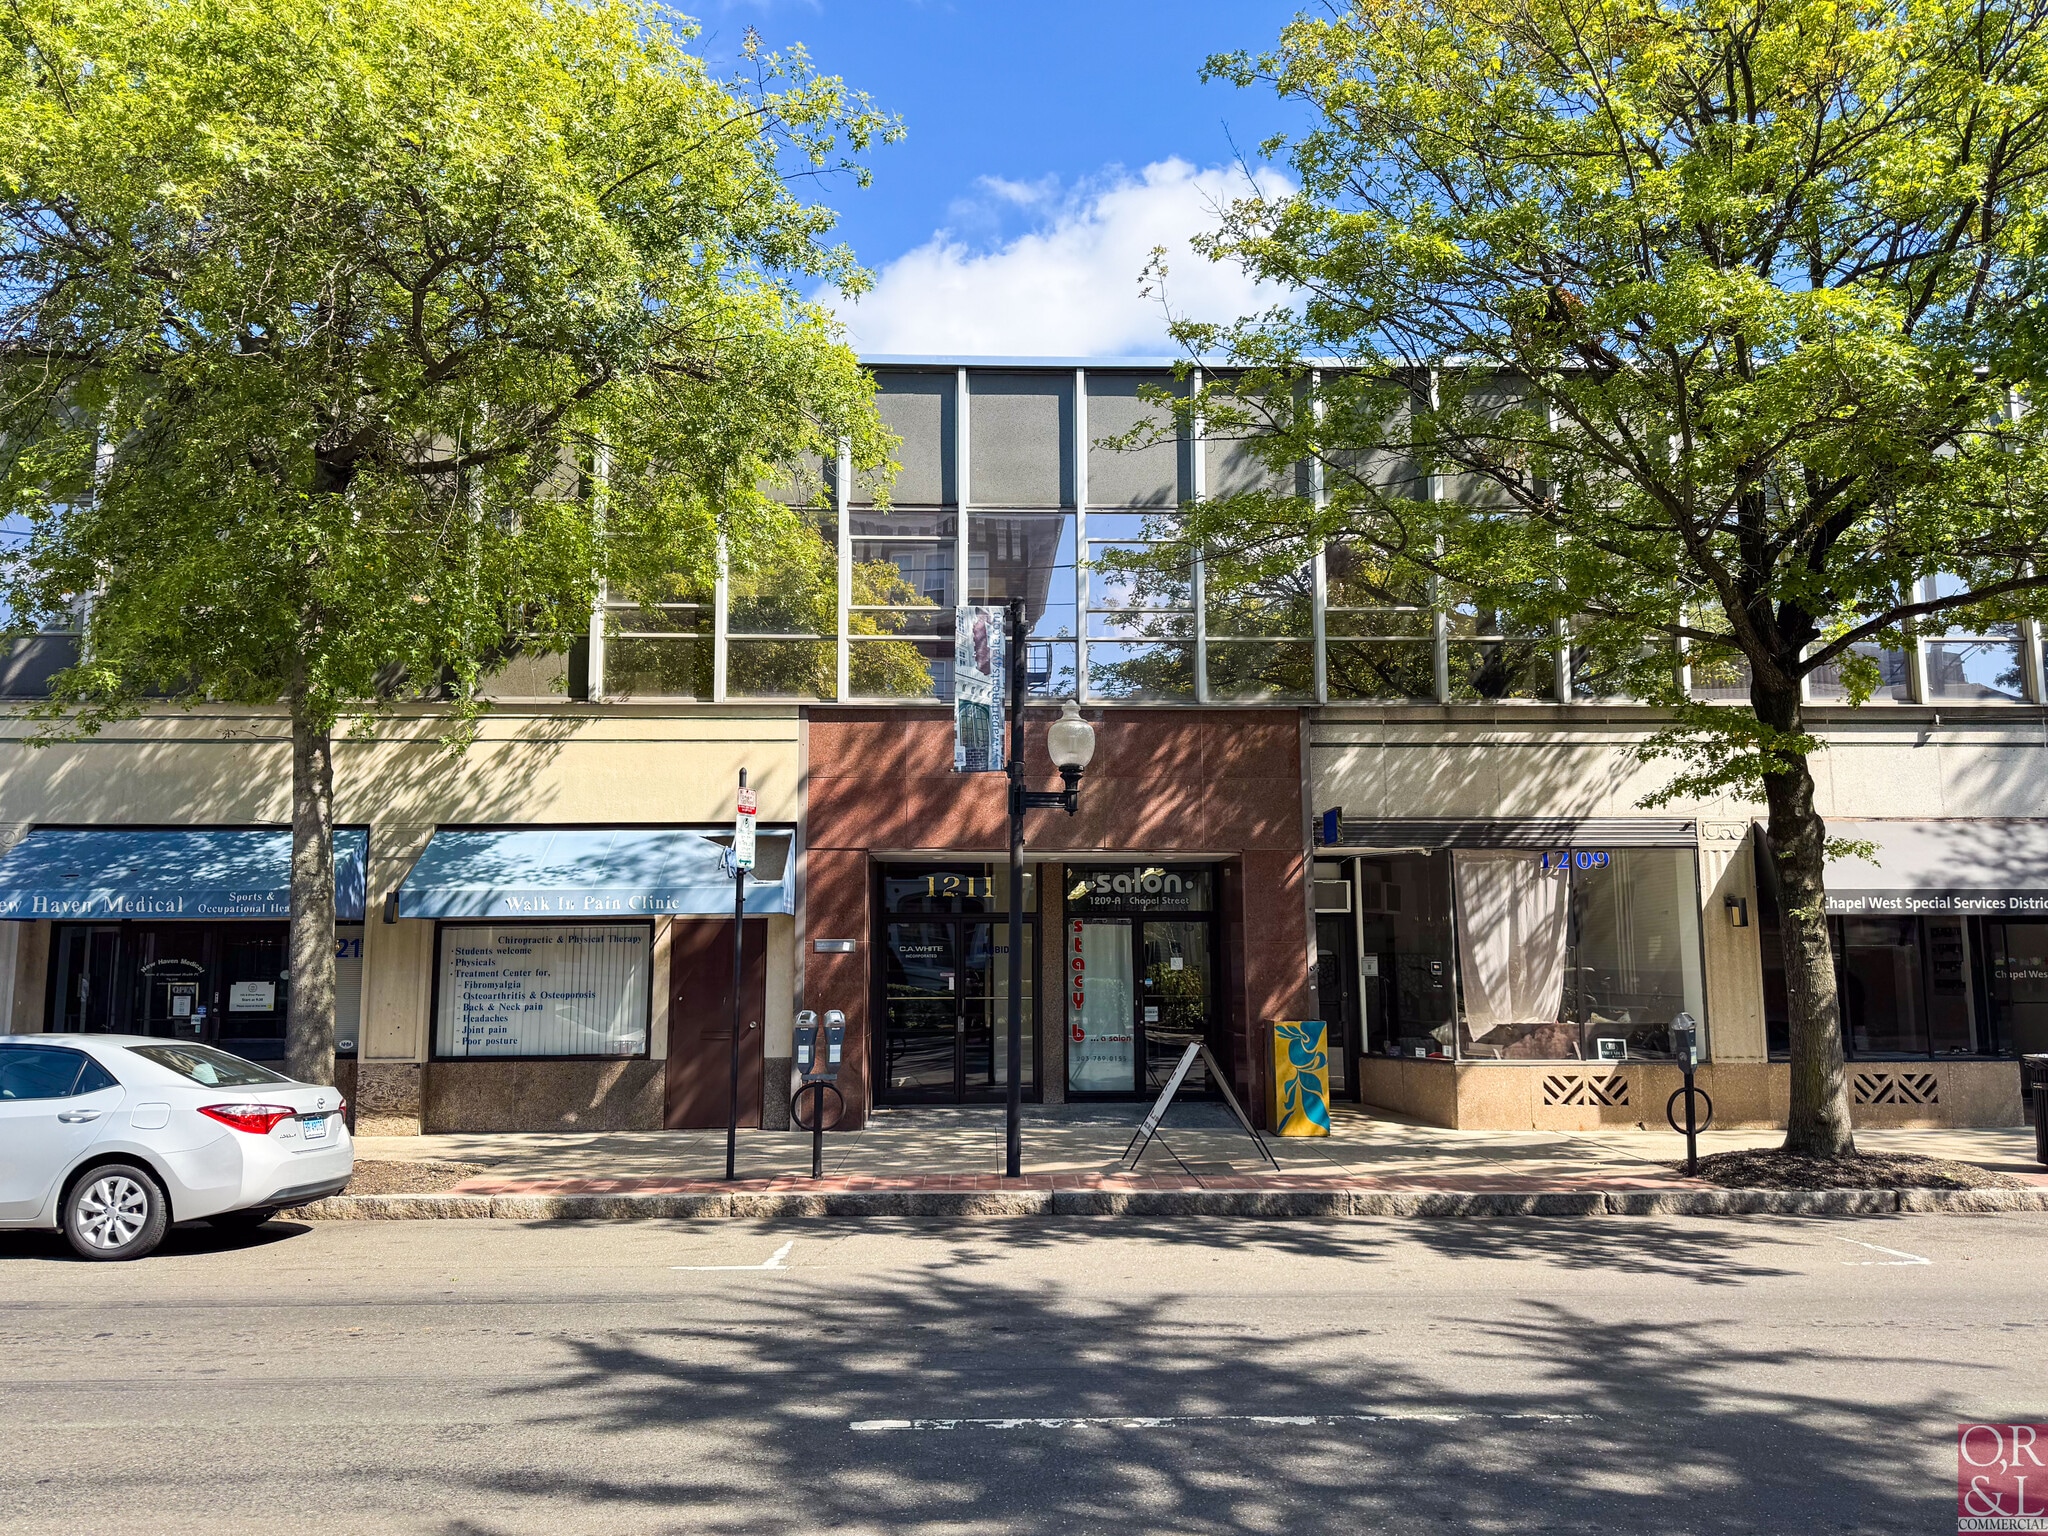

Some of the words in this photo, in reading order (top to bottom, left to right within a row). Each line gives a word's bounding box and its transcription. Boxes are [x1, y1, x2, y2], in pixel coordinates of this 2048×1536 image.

[1096, 867, 1182, 893] salon
[925, 876, 995, 898] 1211
[229, 892, 262, 903] Sports
[267, 892, 275, 901] &
[1089, 896, 1121, 905] 1209-A
[1129, 896, 1160, 906] Chapel
[1161, 896, 1190, 905] Street
[0, 901, 22, 913] ew
[32, 896, 92, 913] Haven
[103, 896, 184, 913] Medical
[505, 896, 550, 911] Walk
[558, 897, 575, 910] In
[583, 896, 621, 910] Pain
[628, 895, 680, 910] Clinic
[1868, 897, 1901, 909] West
[1905, 896, 1951, 912] Special
[1953, 896, 2006, 909] Services
[2009, 896, 2048, 909] Distric
[198, 903, 266, 914] Occupational
[270, 903, 290, 913] Hea
[497, 935, 553, 945] Chiropractic
[556, 936, 564, 944] &
[568, 935, 604, 945] Physical
[607, 935, 642, 944] Therapy
[335, 938, 363, 958] 21
[455, 947, 493, 956] Students
[496, 947, 532, 955] welcome
[140, 960, 156, 973] New
[157, 958, 179, 966] Haven
[180, 958, 206, 974] Medical
[455, 958, 496, 968] Physicals
[455, 969, 499, 978] Treatment
[502, 968, 532, 977] Center
[2028, 970, 2048, 979] Wes
[172, 986, 195, 994] OPEN
[464, 981, 521, 990] Fibromyalgia
[462, 991, 526, 1000] Osteoarthritis
[529, 991, 537, 999] &
[540, 990, 596, 1000] Osteoporosis
[462, 1003, 484, 1012] Back
[487, 1003, 495, 1011] &
[499, 1003, 521, 1011] Neck
[524, 1003, 544, 1013] pain
[462, 1014, 509, 1023] Headaches
[461, 1026, 484, 1034] Joint
[488, 1026, 508, 1036] pain
[462, 1037, 483, 1046] Poor
[485, 1037, 518, 1047] posture
